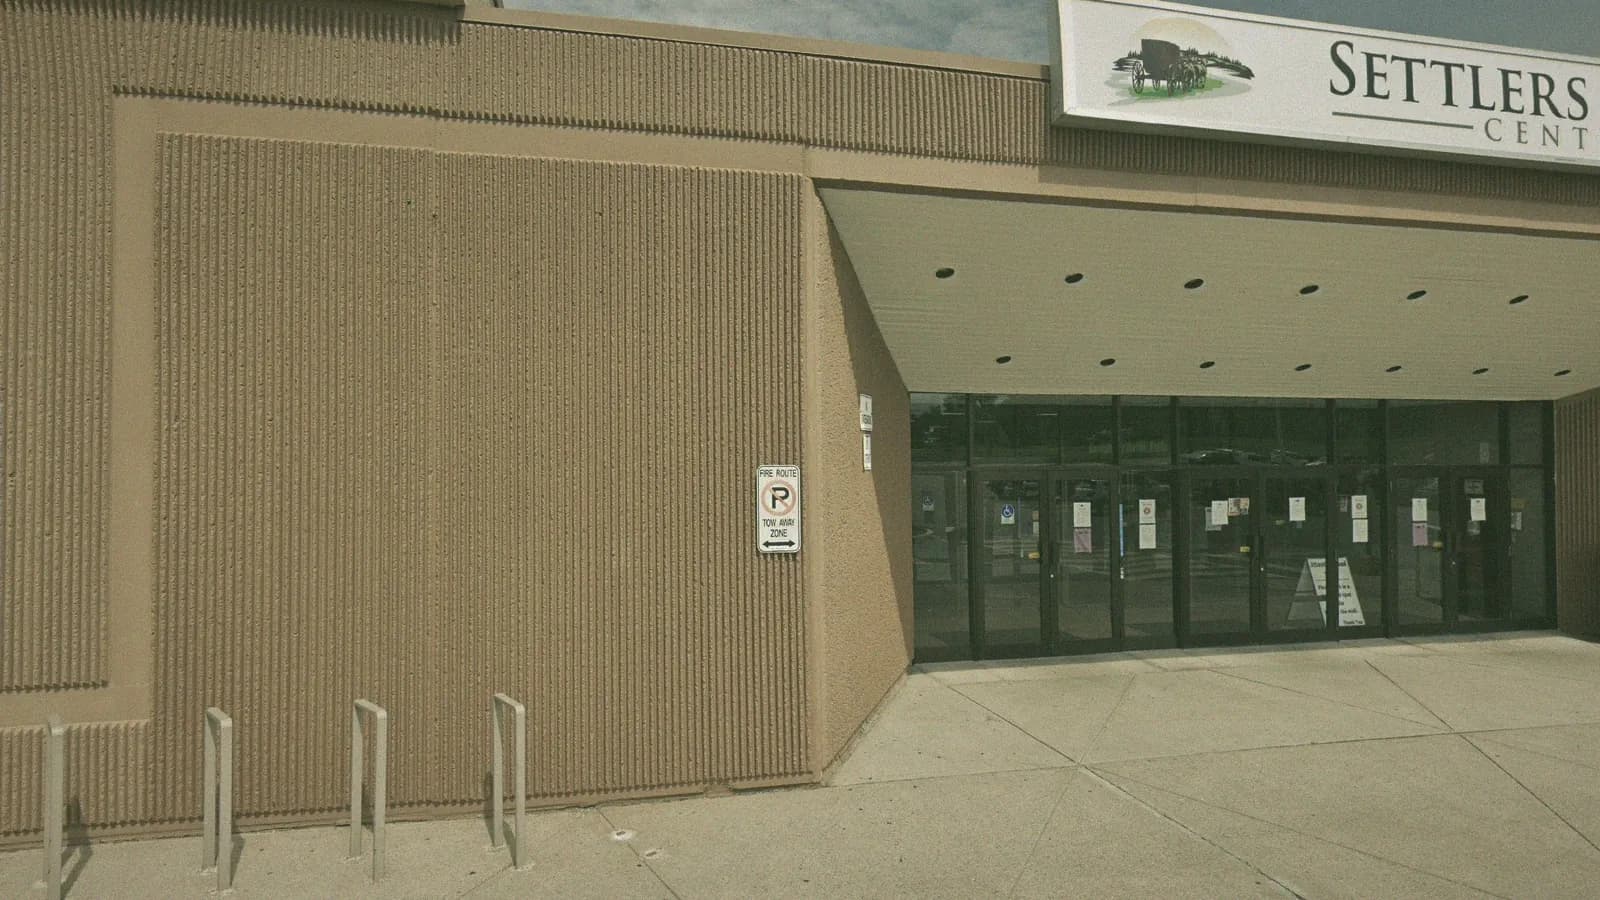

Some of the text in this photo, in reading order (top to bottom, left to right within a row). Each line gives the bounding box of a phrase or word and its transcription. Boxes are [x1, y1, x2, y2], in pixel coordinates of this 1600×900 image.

[1329, 40, 1589, 120] SETTLERS
[1484, 118, 1589, 150] CENT
[759, 469, 797, 478] FIRE ROUTE
[762, 518, 795, 528] TOW AWAY
[770, 528, 788, 538] ZONE
